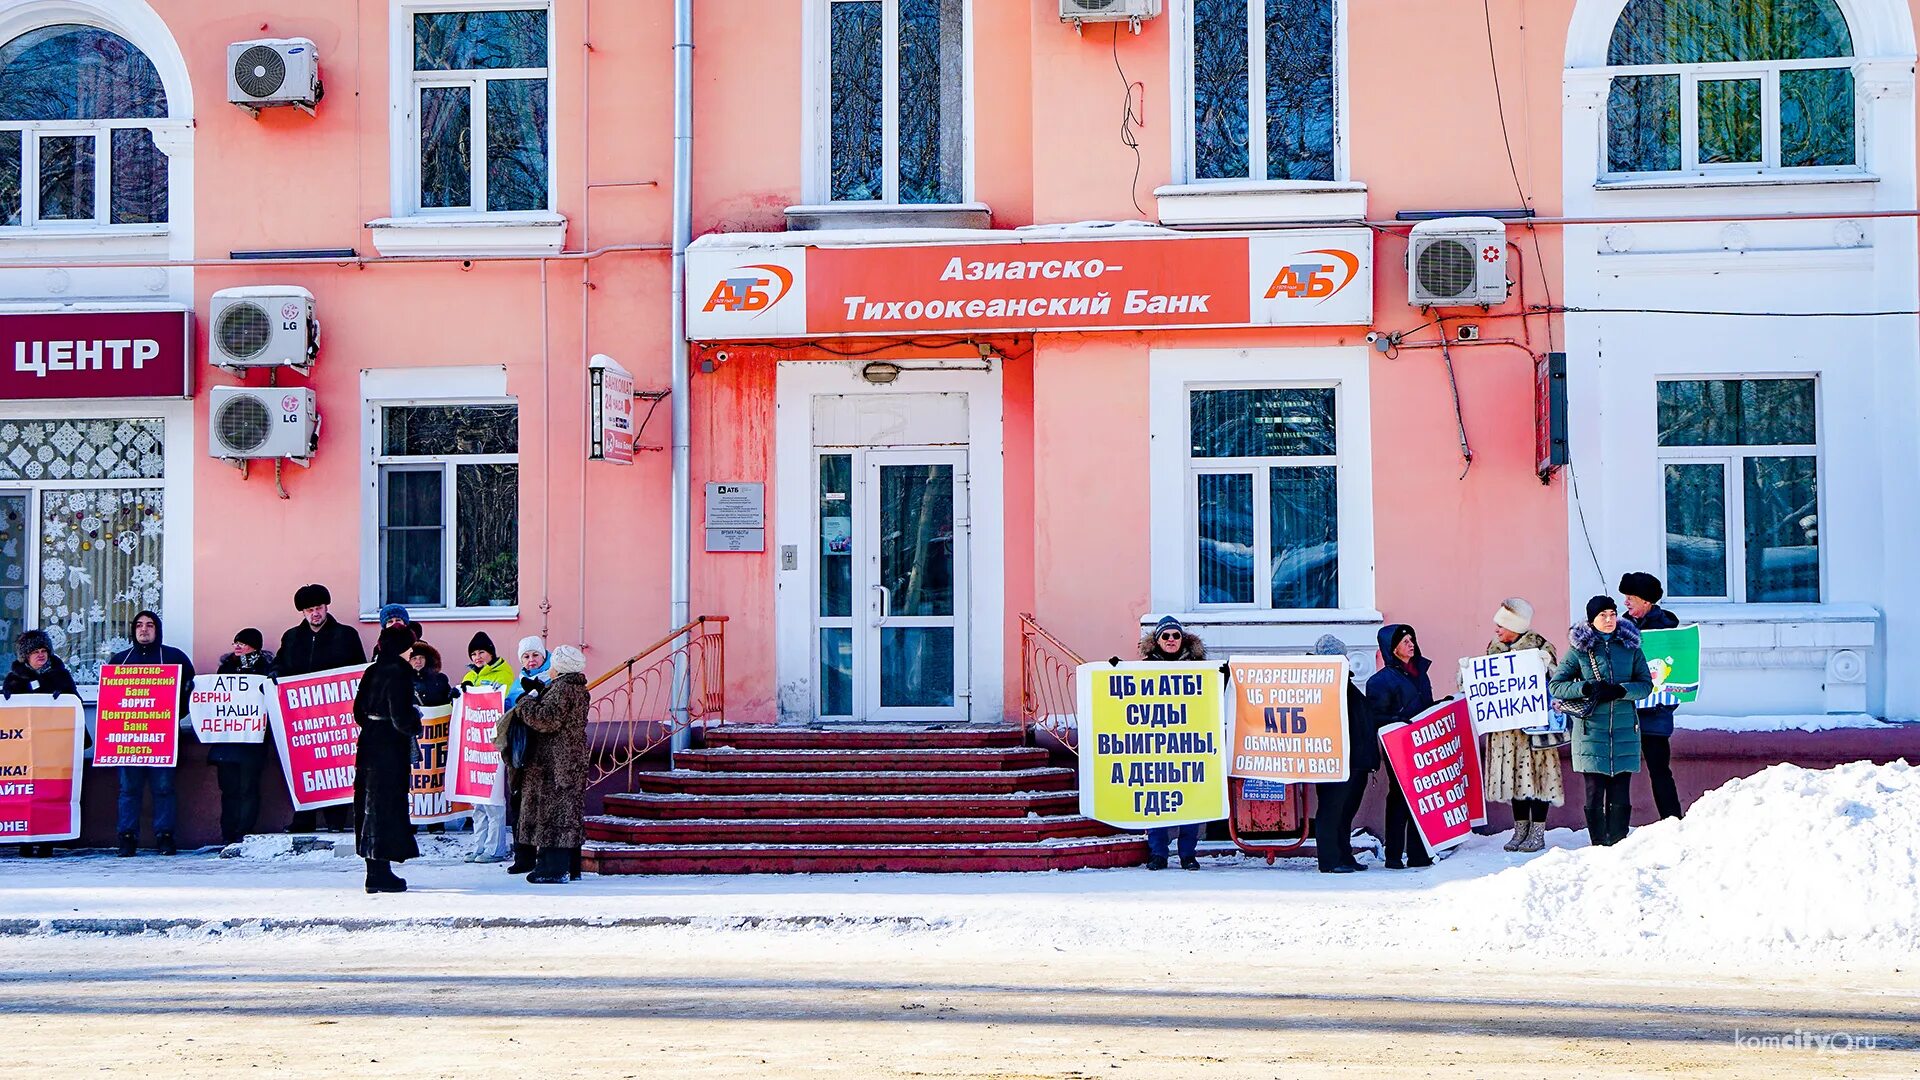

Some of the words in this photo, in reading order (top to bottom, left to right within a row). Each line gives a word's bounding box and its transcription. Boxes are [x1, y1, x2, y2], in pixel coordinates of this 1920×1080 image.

[1263, 264, 1335, 299] АТБ
[702, 278, 770, 312] АТБ
[843, 291, 1112, 321] Тихоокеанский
[1123, 289, 1212, 315] Банк
[283, 321, 297, 330] LG
[15, 339, 160, 377] ЦЕНТР
[283, 414, 297, 423] LG
[114, 666, 164, 675] Азиатско-
[1236, 668, 1244, 684] С
[1247, 668, 1335, 684] РАЗРЕШЕНИЯ
[1474, 654, 1516, 680] НЕТ
[102, 676, 175, 686] Тихоокеанский
[214, 676, 249, 692] АТБ
[1109, 675, 1136, 700] ЦБ
[1141, 678, 1154, 696] и
[1158, 674, 1203, 696] АТБ!
[1469, 674, 1538, 700] ДОВЕРИЯ
[125, 687, 150, 697] Банк
[192, 692, 231, 703] ВЕРНИ
[1246, 688, 1264, 705] ЦБ
[1269, 688, 1323, 704] РОССИИ
[118, 698, 156, 708] -ВОРУЕТ
[216, 705, 259, 717] НАШИ
[1476, 693, 1545, 722] БАНКАМ
[101, 709, 171, 720] Центральный
[200, 714, 267, 733] ДЕНЬГИ!
[1126, 703, 1187, 728] СУДЫ
[1264, 707, 1307, 734] АТБ
[123, 721, 148, 731] Банк
[292, 720, 304, 733] 14
[304, 715, 337, 731] МАРТА
[104, 733, 166, 743] -ПОКРЫВАЕТ
[291, 728, 348, 747] СОСТОИТСЯ
[1097, 732, 1218, 755] ВЫИГРАНЫ,
[1244, 735, 1302, 753] ОБМАНУЛ
[1305, 737, 1332, 753] НАС
[116, 744, 153, 754] Власть
[314, 745, 328, 759] ПО
[412, 742, 448, 770] ТБ
[96, 754, 171, 764] -БЕЗДЕЙСТВУЕТ
[1236, 755, 1294, 773] ОБМАНЕТ
[1297, 757, 1306, 773] И
[1309, 757, 1340, 773] ВАС!
[1111, 763, 1124, 784] А
[1128, 761, 1205, 787] ДЕНЬГИ
[1134, 790, 1184, 816] ГДЕ?
[1418, 791, 1445, 816] АТБ
